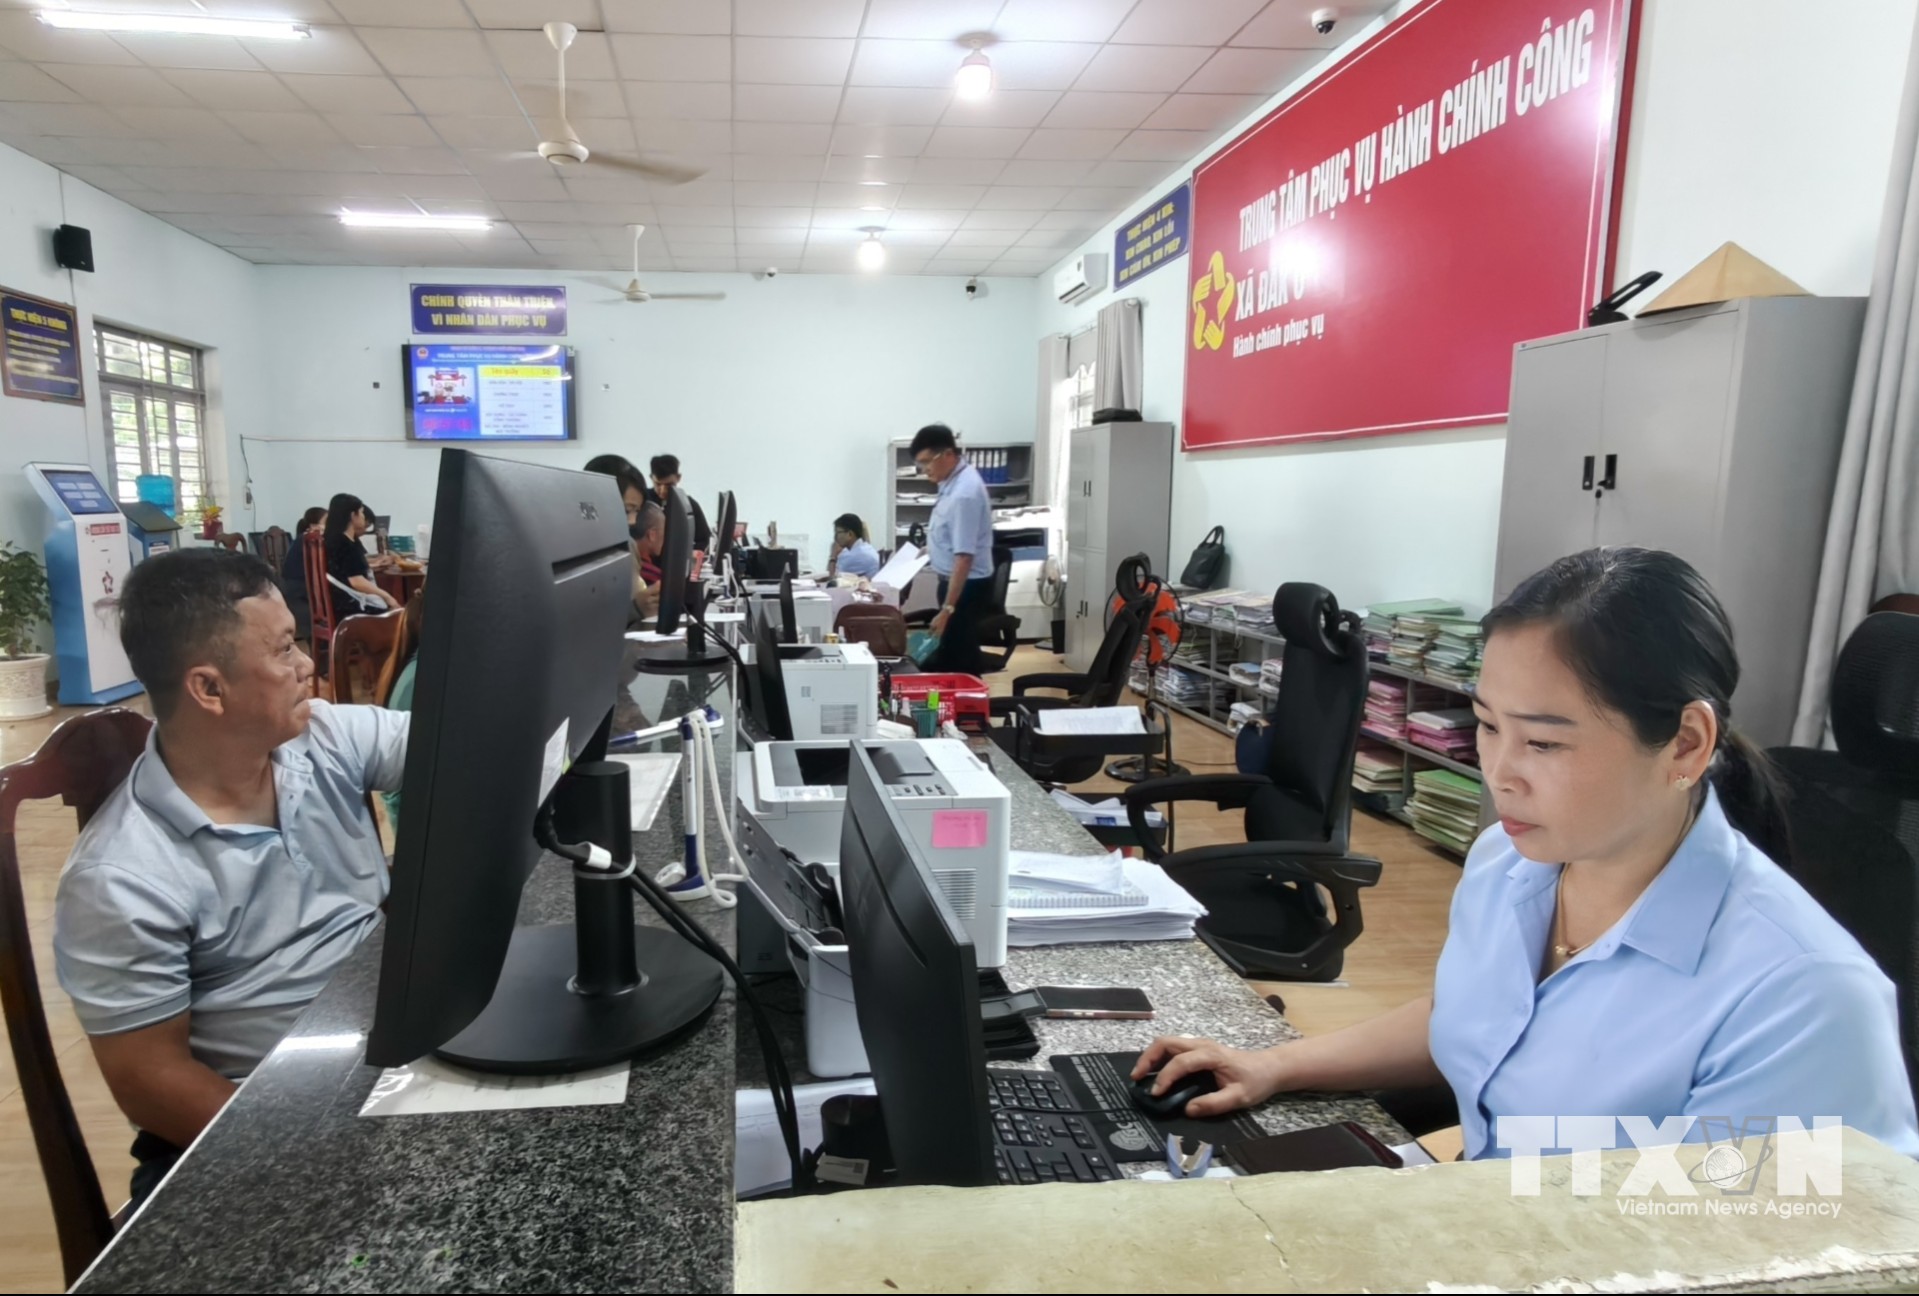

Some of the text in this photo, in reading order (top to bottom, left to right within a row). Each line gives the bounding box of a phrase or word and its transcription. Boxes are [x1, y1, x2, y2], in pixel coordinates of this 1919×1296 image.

[1239, 8, 1595, 253] TRUNG TÂM PHỤC VỤ HÀNH CHÍNH CÔNG
[421, 294, 455, 307] CHÍNH
[457, 292, 491, 309] QUYỀN
[431, 312, 548, 329] VÌ NHÂN DÂN PHỤC VỤ
[1232, 313, 1325, 358] Hành chính phục vụ
